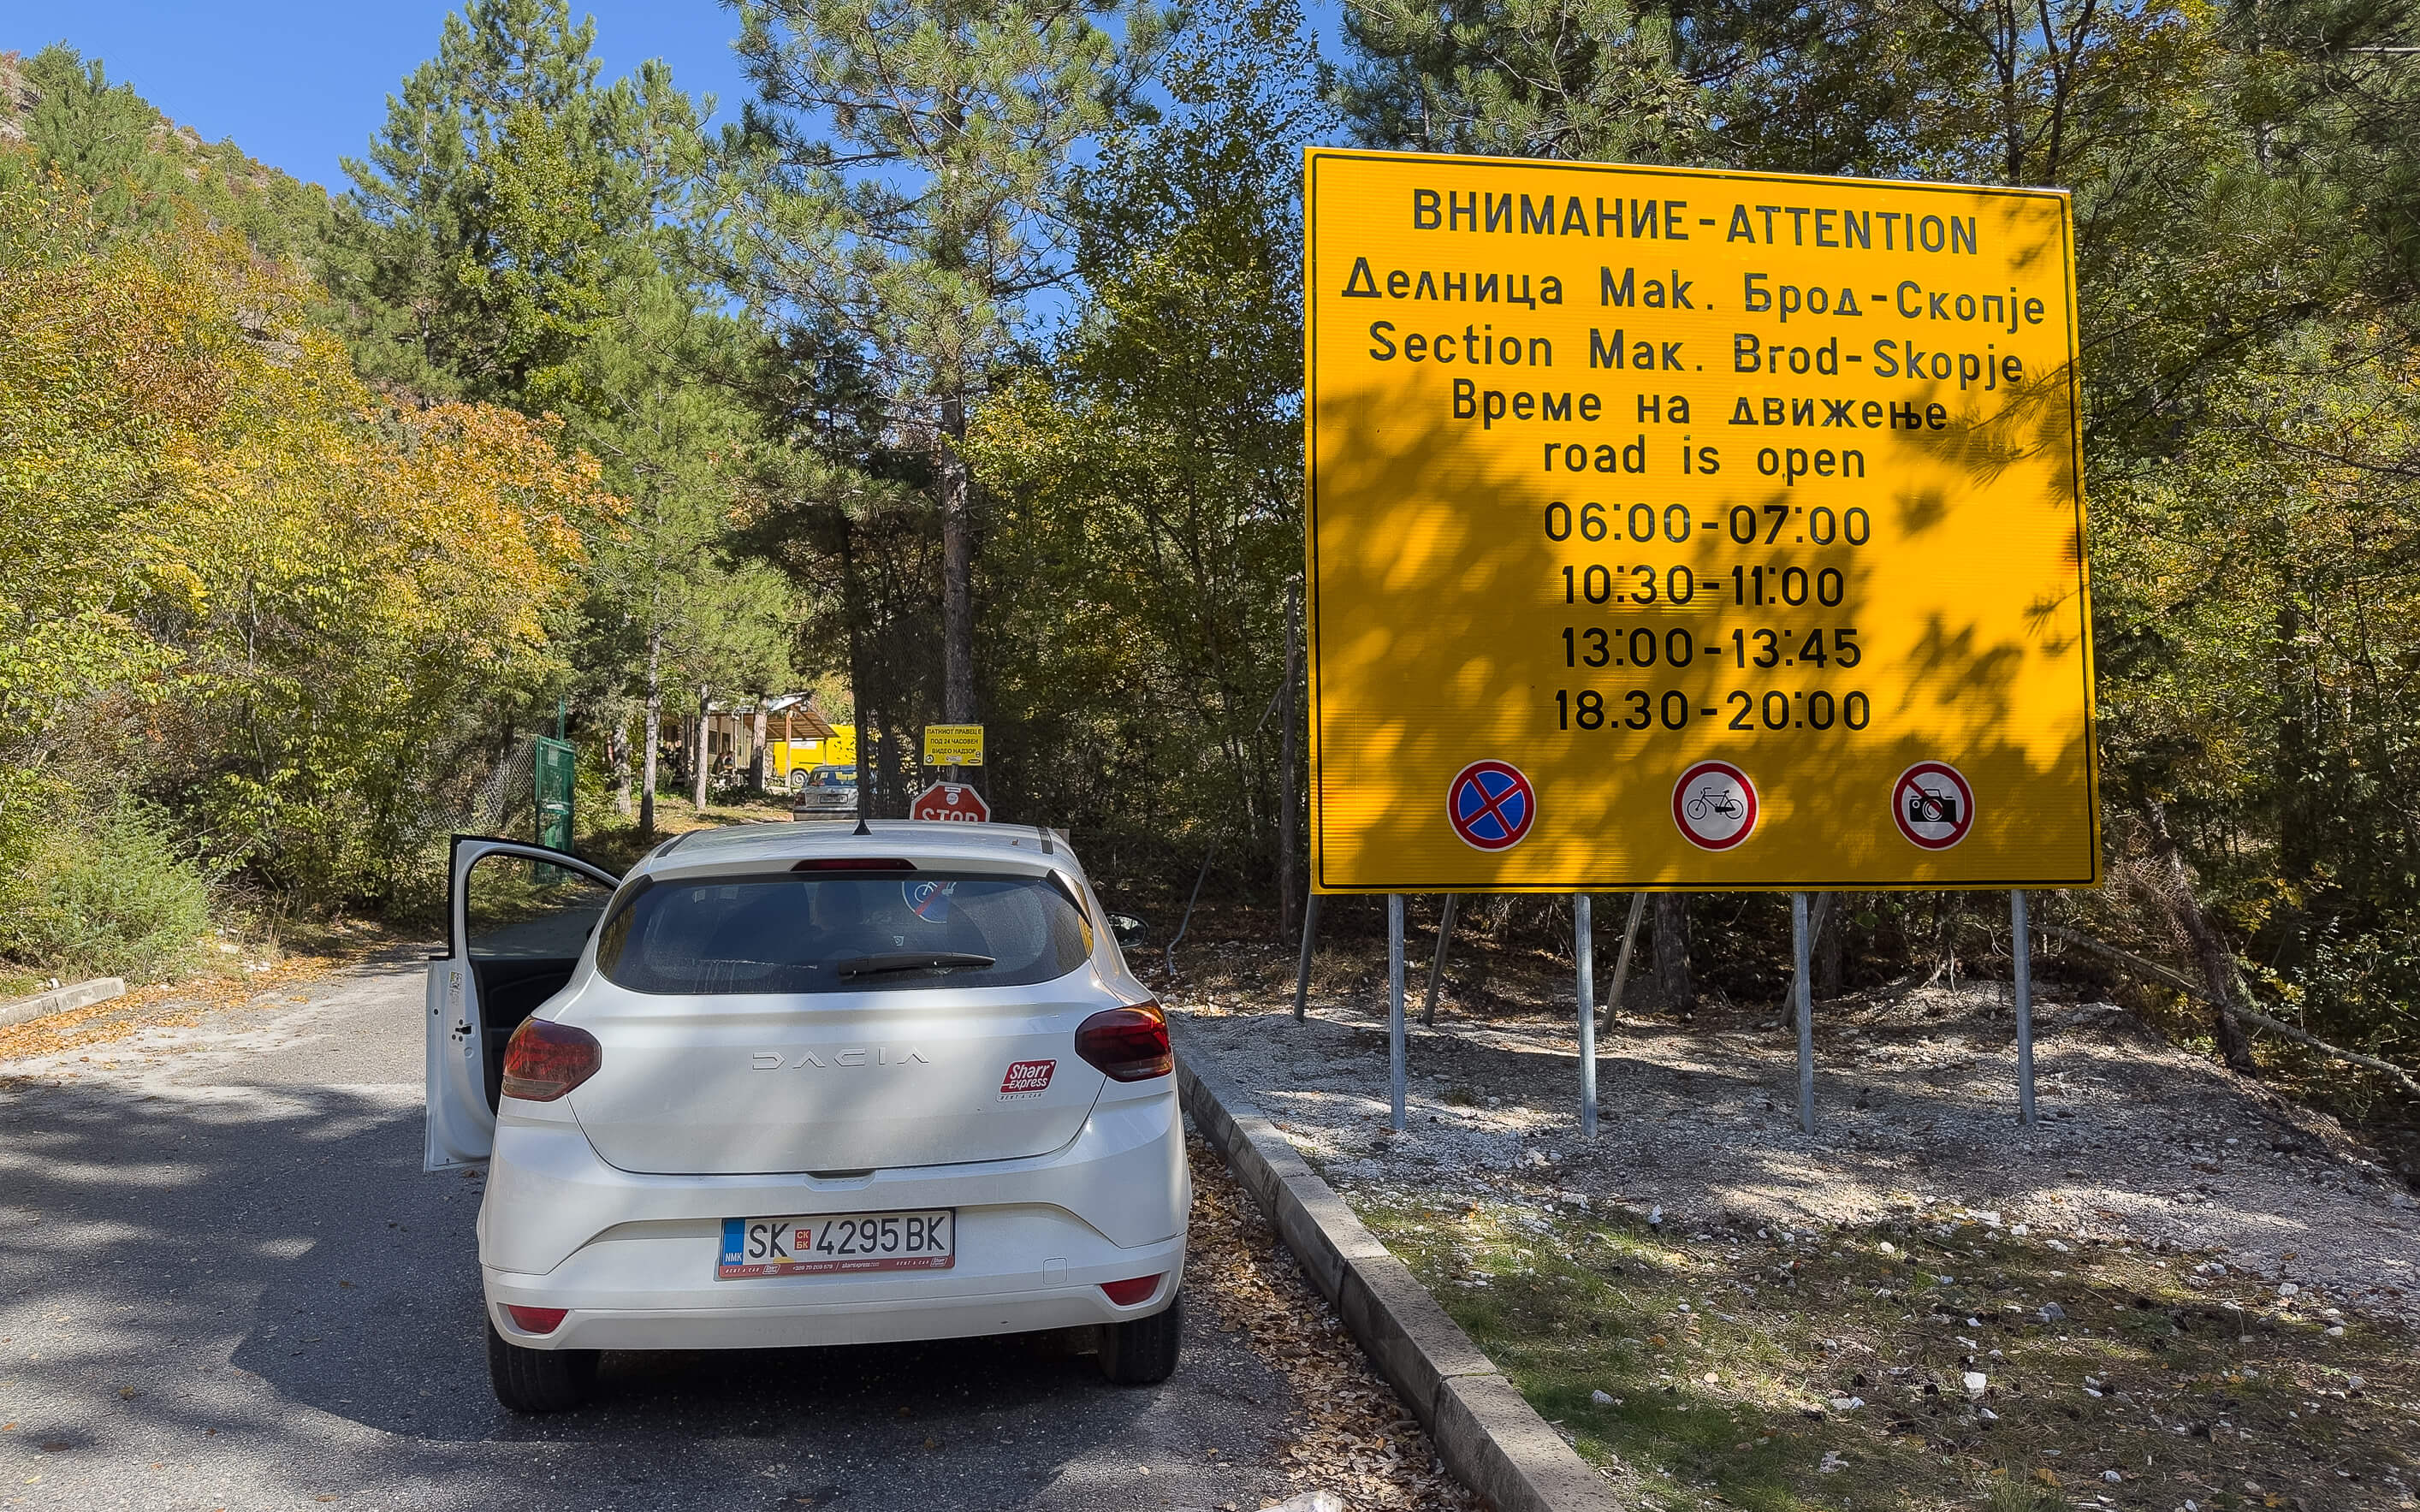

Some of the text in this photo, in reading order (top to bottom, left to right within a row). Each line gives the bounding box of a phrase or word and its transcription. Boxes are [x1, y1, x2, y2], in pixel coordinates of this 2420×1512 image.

[1341, 257, 1563, 311] Делница
[1369, 321, 1551, 367] Section
[1453, 378, 1947, 431] Време на движење
[1545, 434, 1865, 487] road is open
[752, 1047, 930, 1070] DACIA
[1010, 1064, 1050, 1080] Sharr
[725, 1252, 743, 1262] NMK
[749, 1216, 946, 1259] SK 4295 BK
